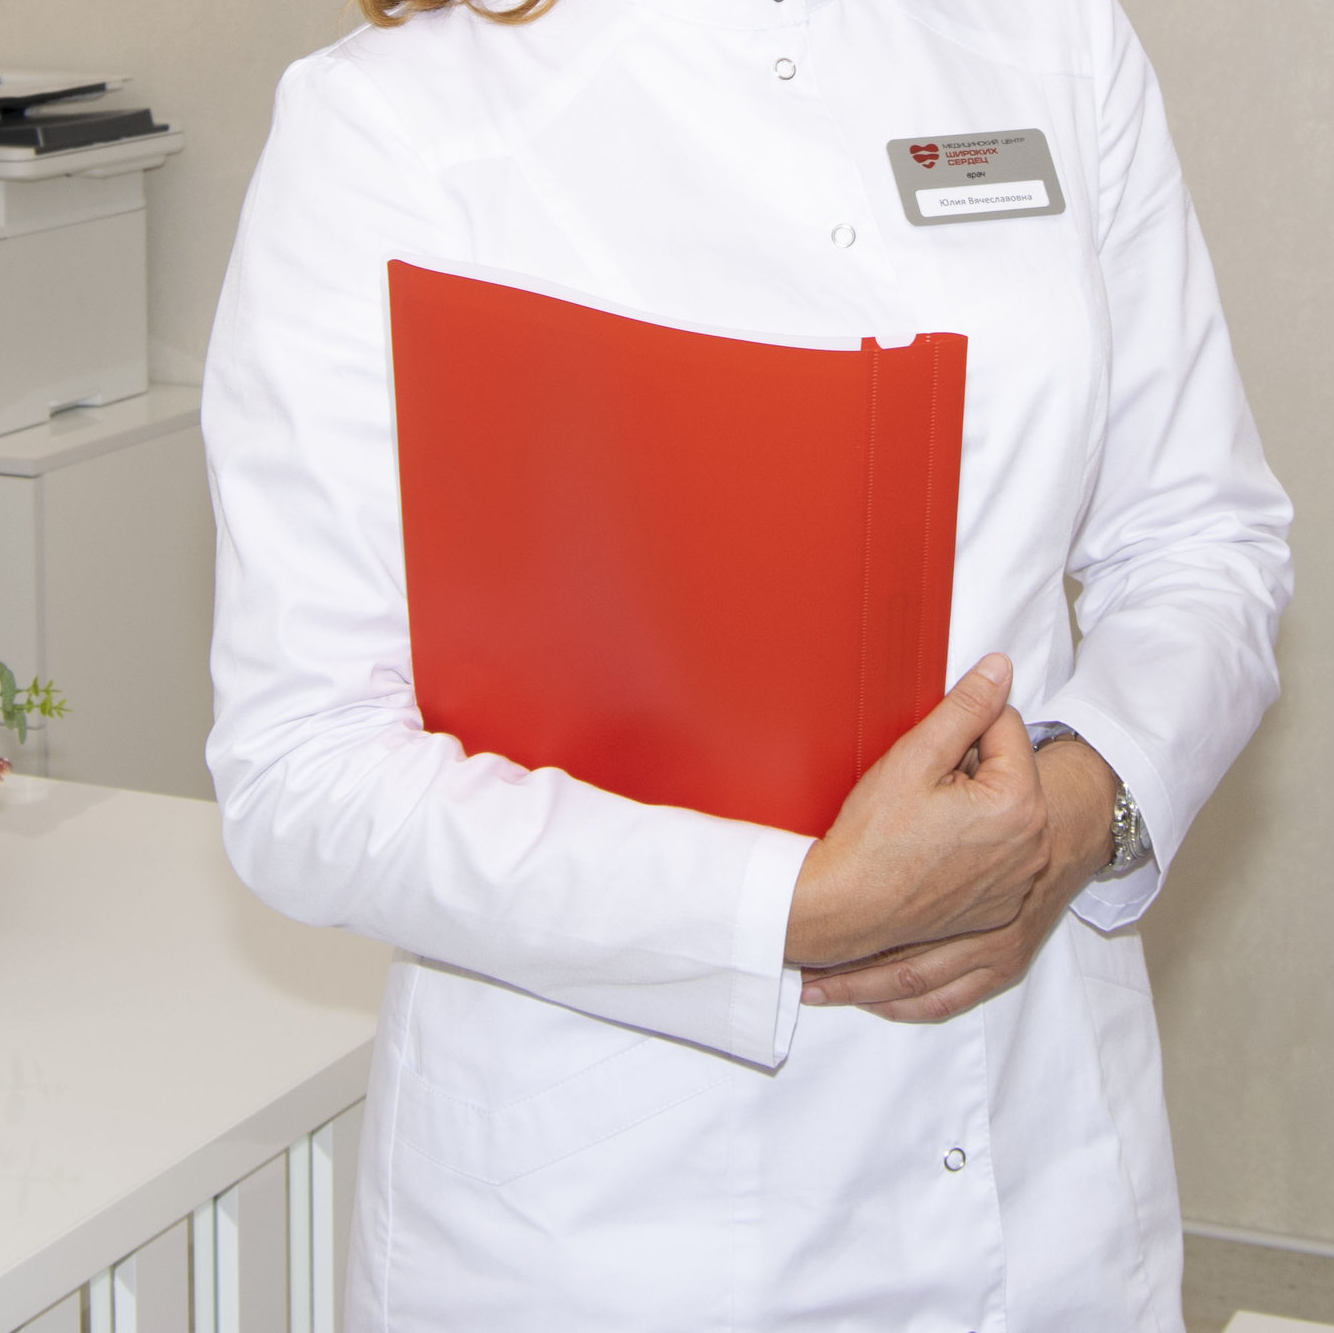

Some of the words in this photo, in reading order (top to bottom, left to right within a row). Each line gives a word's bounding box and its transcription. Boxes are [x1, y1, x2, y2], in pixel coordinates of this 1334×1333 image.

[1001, 137, 1026, 145] ЦЕНТР
[945, 147, 998, 158] ШИРОКИХ
[947, 156, 989, 166] СЕРДЕЦ
[967, 171, 986, 179] врач
[939, 198, 966, 207] Юлия
[968, 194, 1033, 205] Вячеславовна
